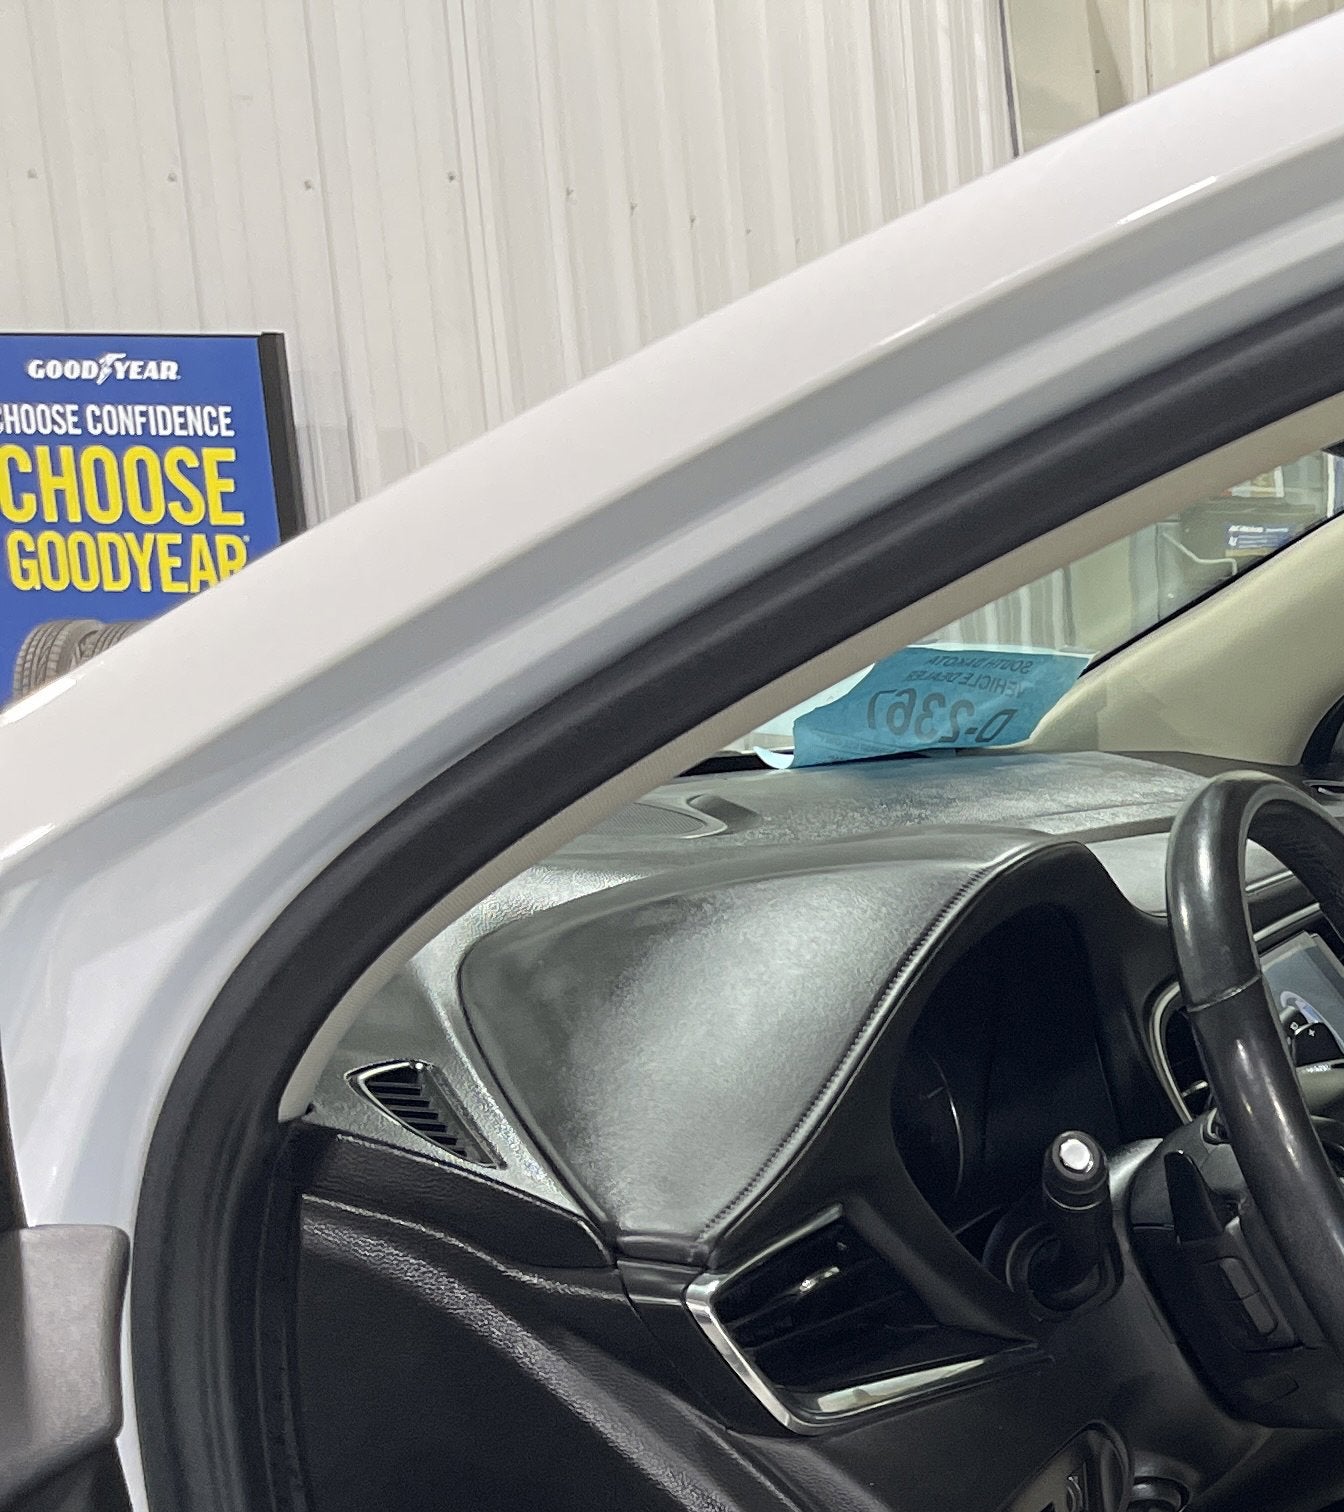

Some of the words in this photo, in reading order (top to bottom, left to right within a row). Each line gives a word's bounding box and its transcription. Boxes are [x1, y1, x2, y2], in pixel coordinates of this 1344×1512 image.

[27, 352, 181, 385] GOODYEAR
[0, 403, 82, 436] HOOSE
[86, 404, 235, 437] CONFIDENCE
[0, 443, 246, 526] CHOOSE
